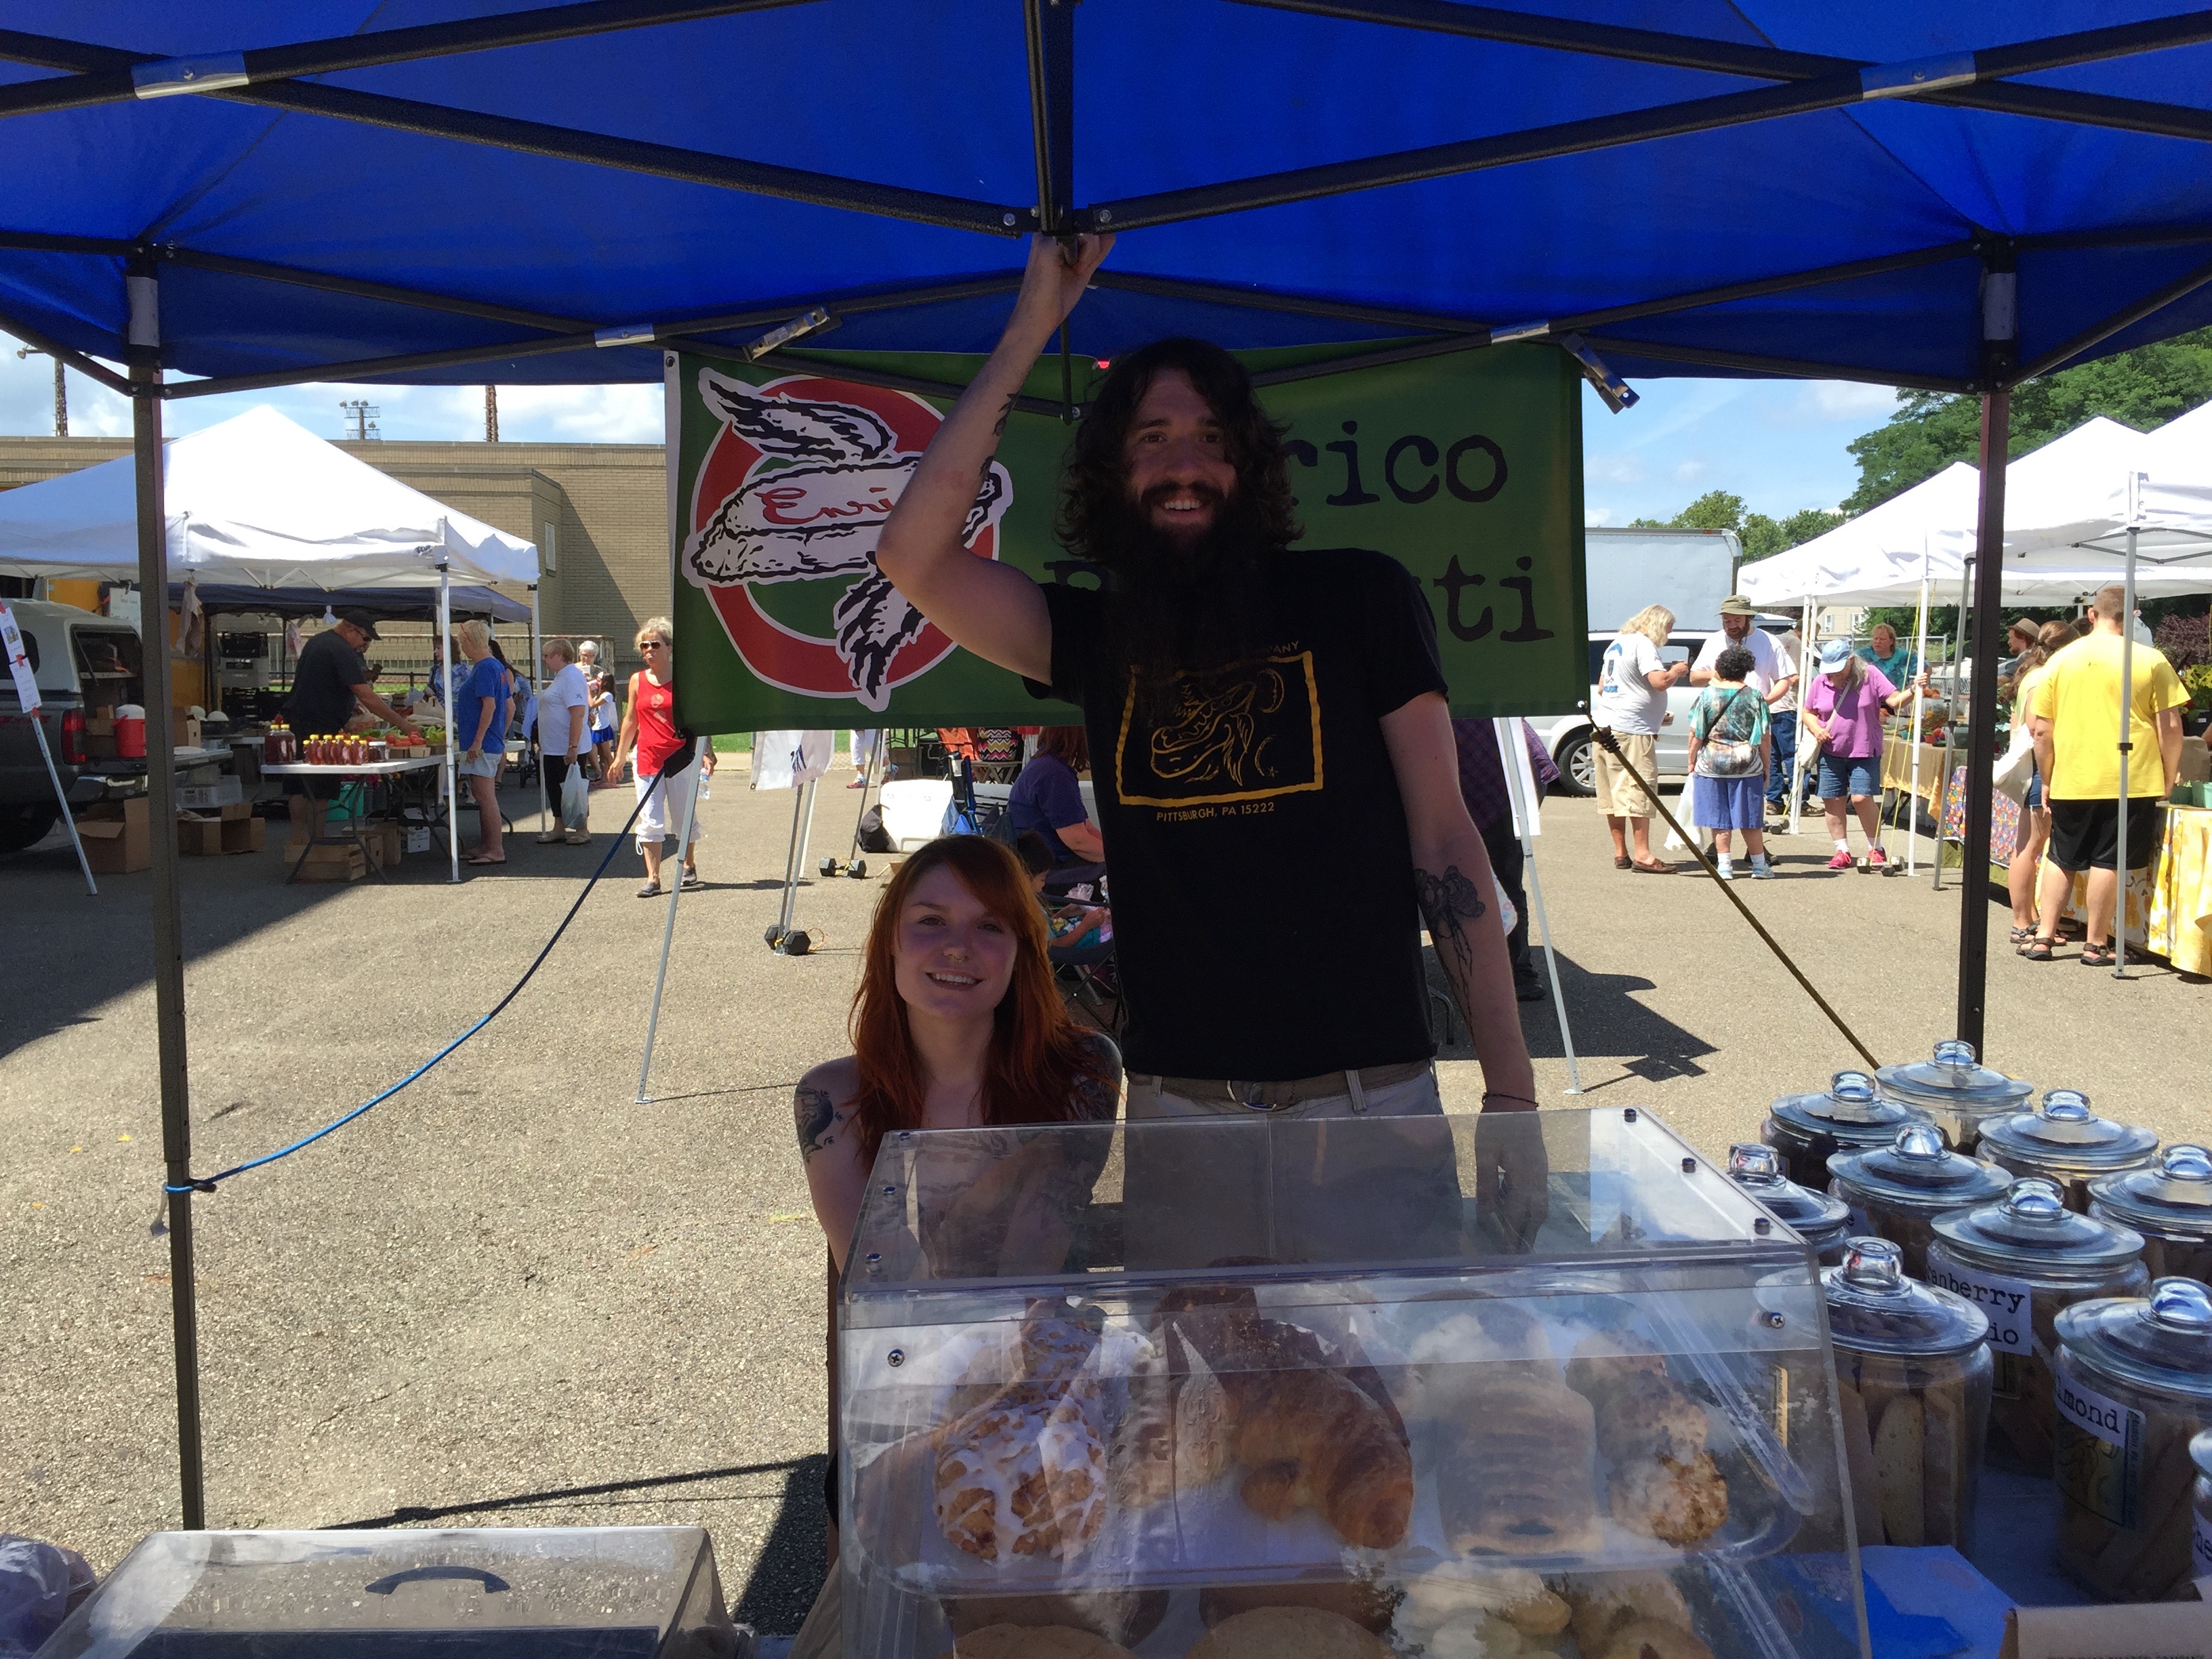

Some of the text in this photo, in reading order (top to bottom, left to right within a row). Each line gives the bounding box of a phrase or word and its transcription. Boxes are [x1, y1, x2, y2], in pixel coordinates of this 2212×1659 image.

[1155, 801, 1275, 822] PITTSBURGH, PA 15222
